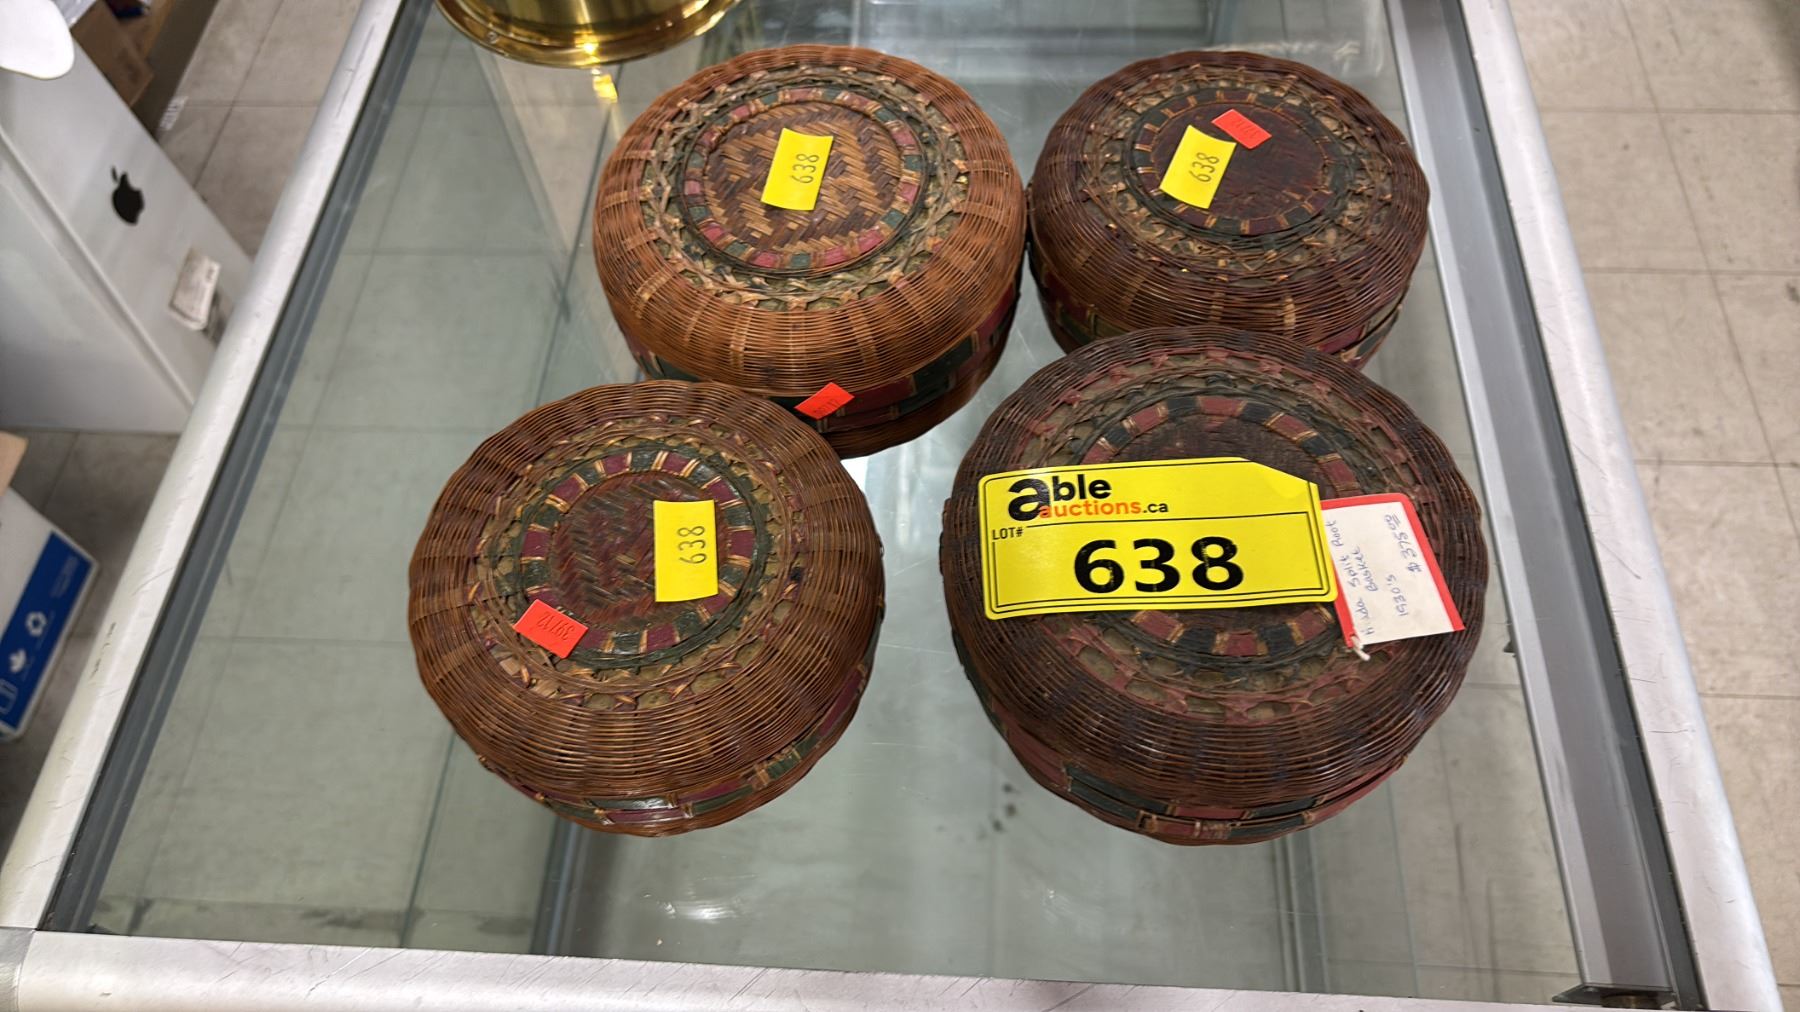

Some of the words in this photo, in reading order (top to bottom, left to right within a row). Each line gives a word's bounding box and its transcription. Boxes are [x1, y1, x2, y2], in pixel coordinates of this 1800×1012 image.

[790, 153, 820, 184] 638
[1189, 152, 1220, 183] 638
[1008, 474, 1112, 521] able
[1039, 500, 1169, 519] auctions.ca
[677, 526, 707, 564] 638
[992, 527, 1023, 541] LOT#
[1325, 520, 1343, 547] Root
[1074, 536, 1244, 594] 638
[1339, 555, 1360, 588] Split
[1351, 546, 1378, 592] Basket
[1355, 598, 1375, 635] Hida
